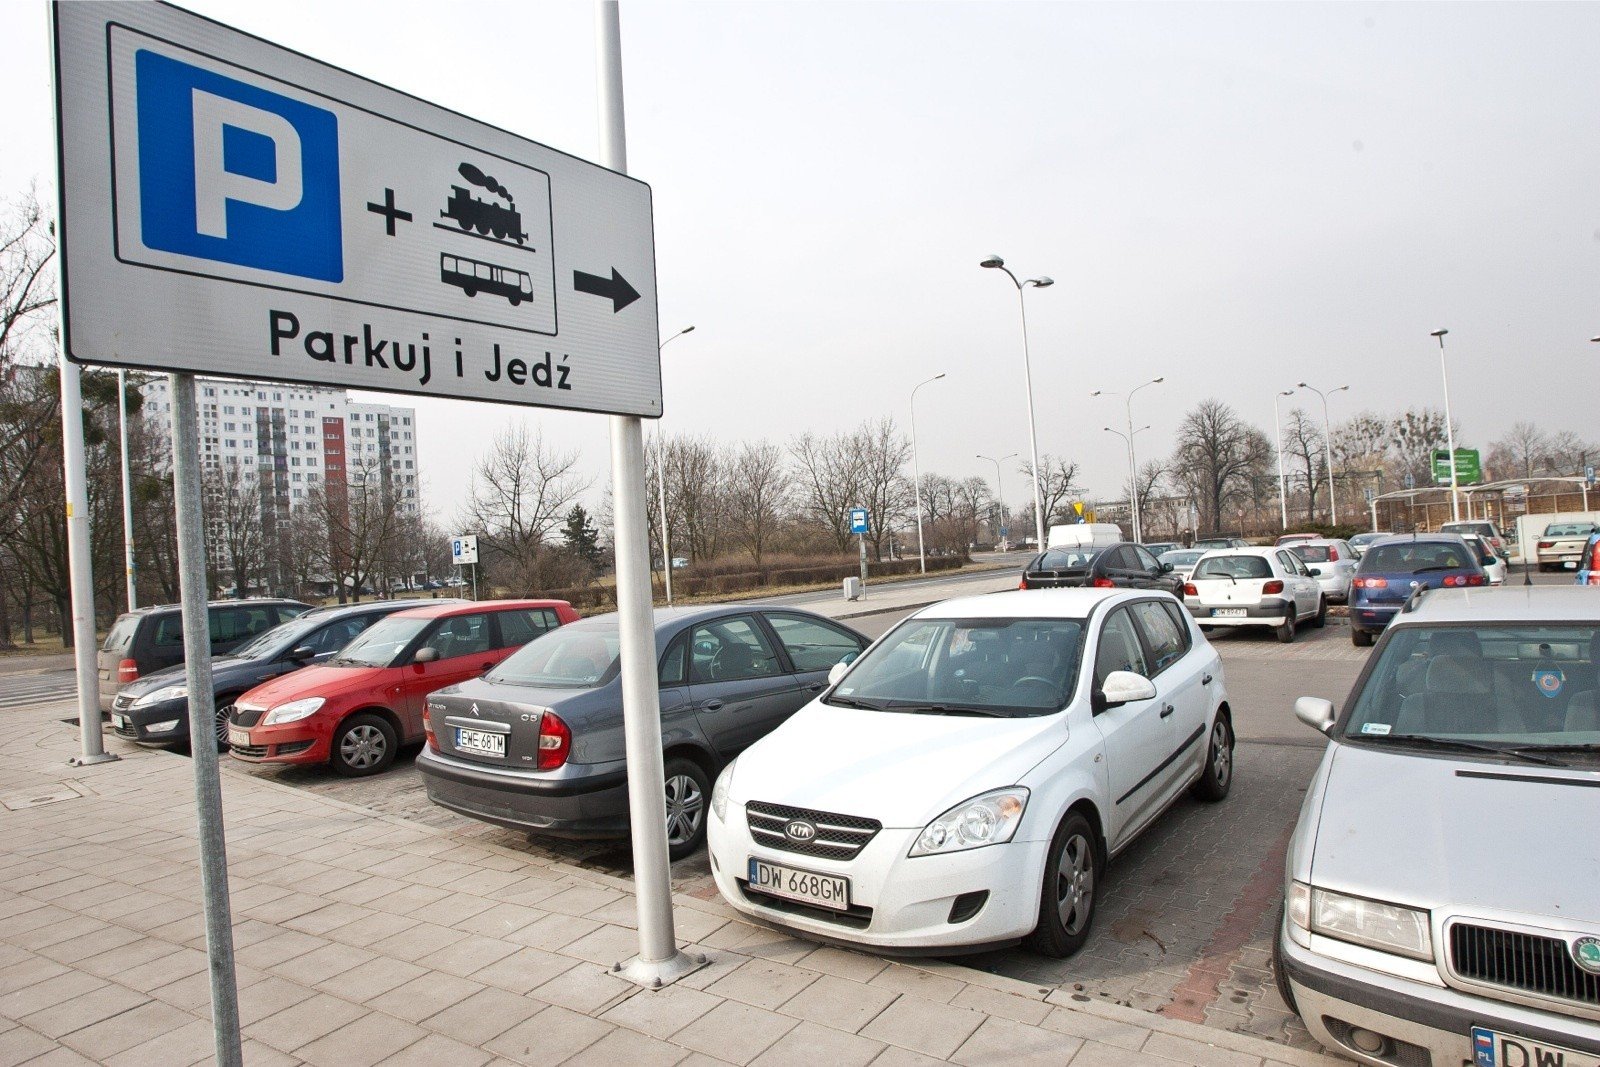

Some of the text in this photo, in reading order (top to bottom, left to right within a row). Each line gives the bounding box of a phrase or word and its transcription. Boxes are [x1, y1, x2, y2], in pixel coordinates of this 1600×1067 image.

[192, 87, 304, 240] P
[269, 309, 572, 391] Parkuj i Jedź
[461, 731, 479, 748] EWE
[480, 737, 504, 754] 68TM
[789, 824, 810, 838] KIA
[759, 864, 782, 889] DW
[788, 872, 844, 902] 668GM
[1478, 1051, 1492, 1062] PL
